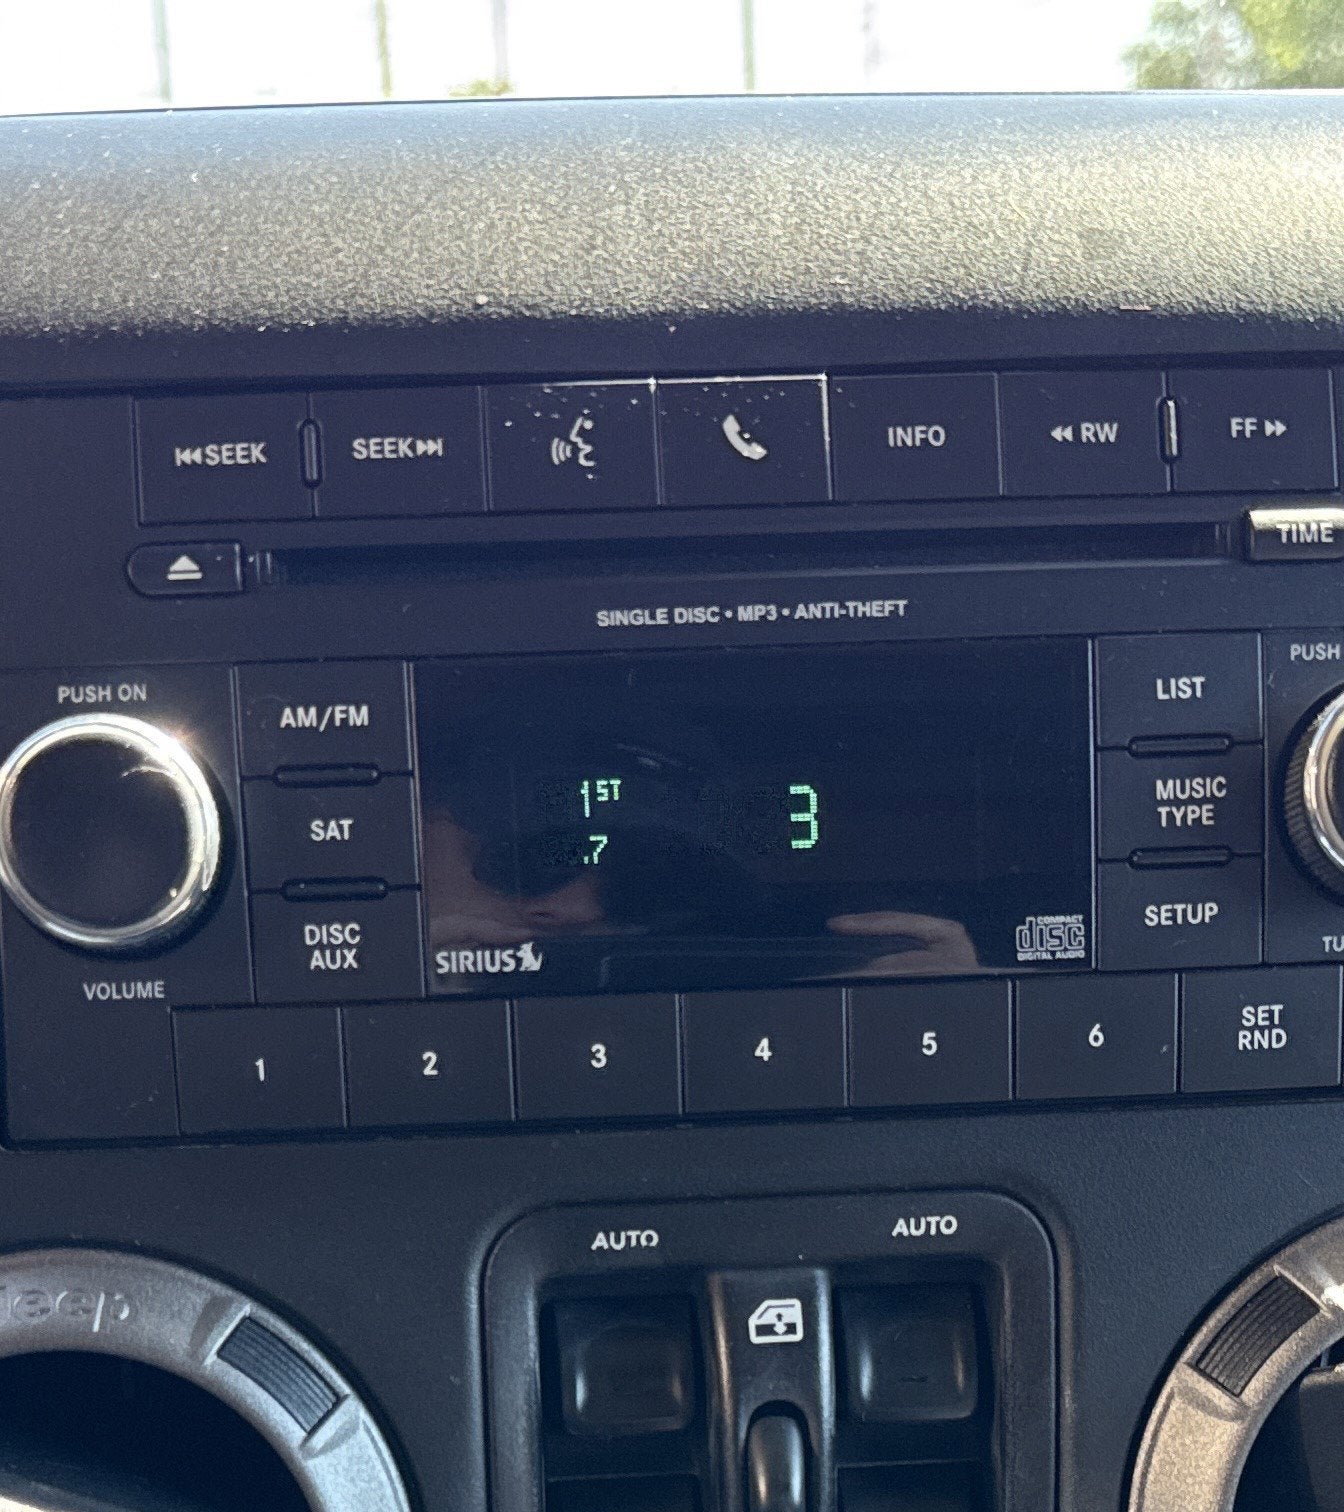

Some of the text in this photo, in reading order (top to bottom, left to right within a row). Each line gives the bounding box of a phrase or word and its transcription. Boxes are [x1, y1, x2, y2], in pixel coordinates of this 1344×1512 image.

[887, 425, 946, 447] INFO
[1080, 422, 1118, 444] RW
[1229, 417, 1257, 438] FF
[205, 442, 267, 467] SEEK
[352, 436, 414, 460] SEEK
[1276, 521, 1335, 544] TIME
[596, 600, 907, 627] SINGLE DISC MP3 ANTI-THEFT
[1289, 642, 1341, 662] PUSH
[57, 683, 148, 704] PUSH ON
[1156, 677, 1205, 700] LIST
[279, 705, 369, 733] AM/FM
[1156, 776, 1228, 801] MUSIC
[789, 784, 818, 849] 3
[1157, 804, 1216, 827] TYPE
[309, 818, 354, 842] SAT
[1036, 914, 1083, 924] COMPACT
[1144, 903, 1219, 927] SETUP
[304, 923, 361, 947] DISC
[309, 948, 359, 972] AUX
[435, 949, 515, 974] SIRIUS
[1017, 949, 1085, 961] DIGITAL AUDIO
[82, 980, 166, 1001] VOLUME
[1241, 1005, 1284, 1028] SET
[921, 1031, 938, 1057] 5
[1087, 1024, 1105, 1048] 6
[1237, 1027, 1288, 1051] RND
[590, 1043, 608, 1069] 3
[754, 1037, 773, 1062] 4
[253, 1057, 268, 1083] 1
[422, 1051, 439, 1077] 2
[891, 1214, 958, 1238] AUTO
[591, 1229, 659, 1250] AUTO
